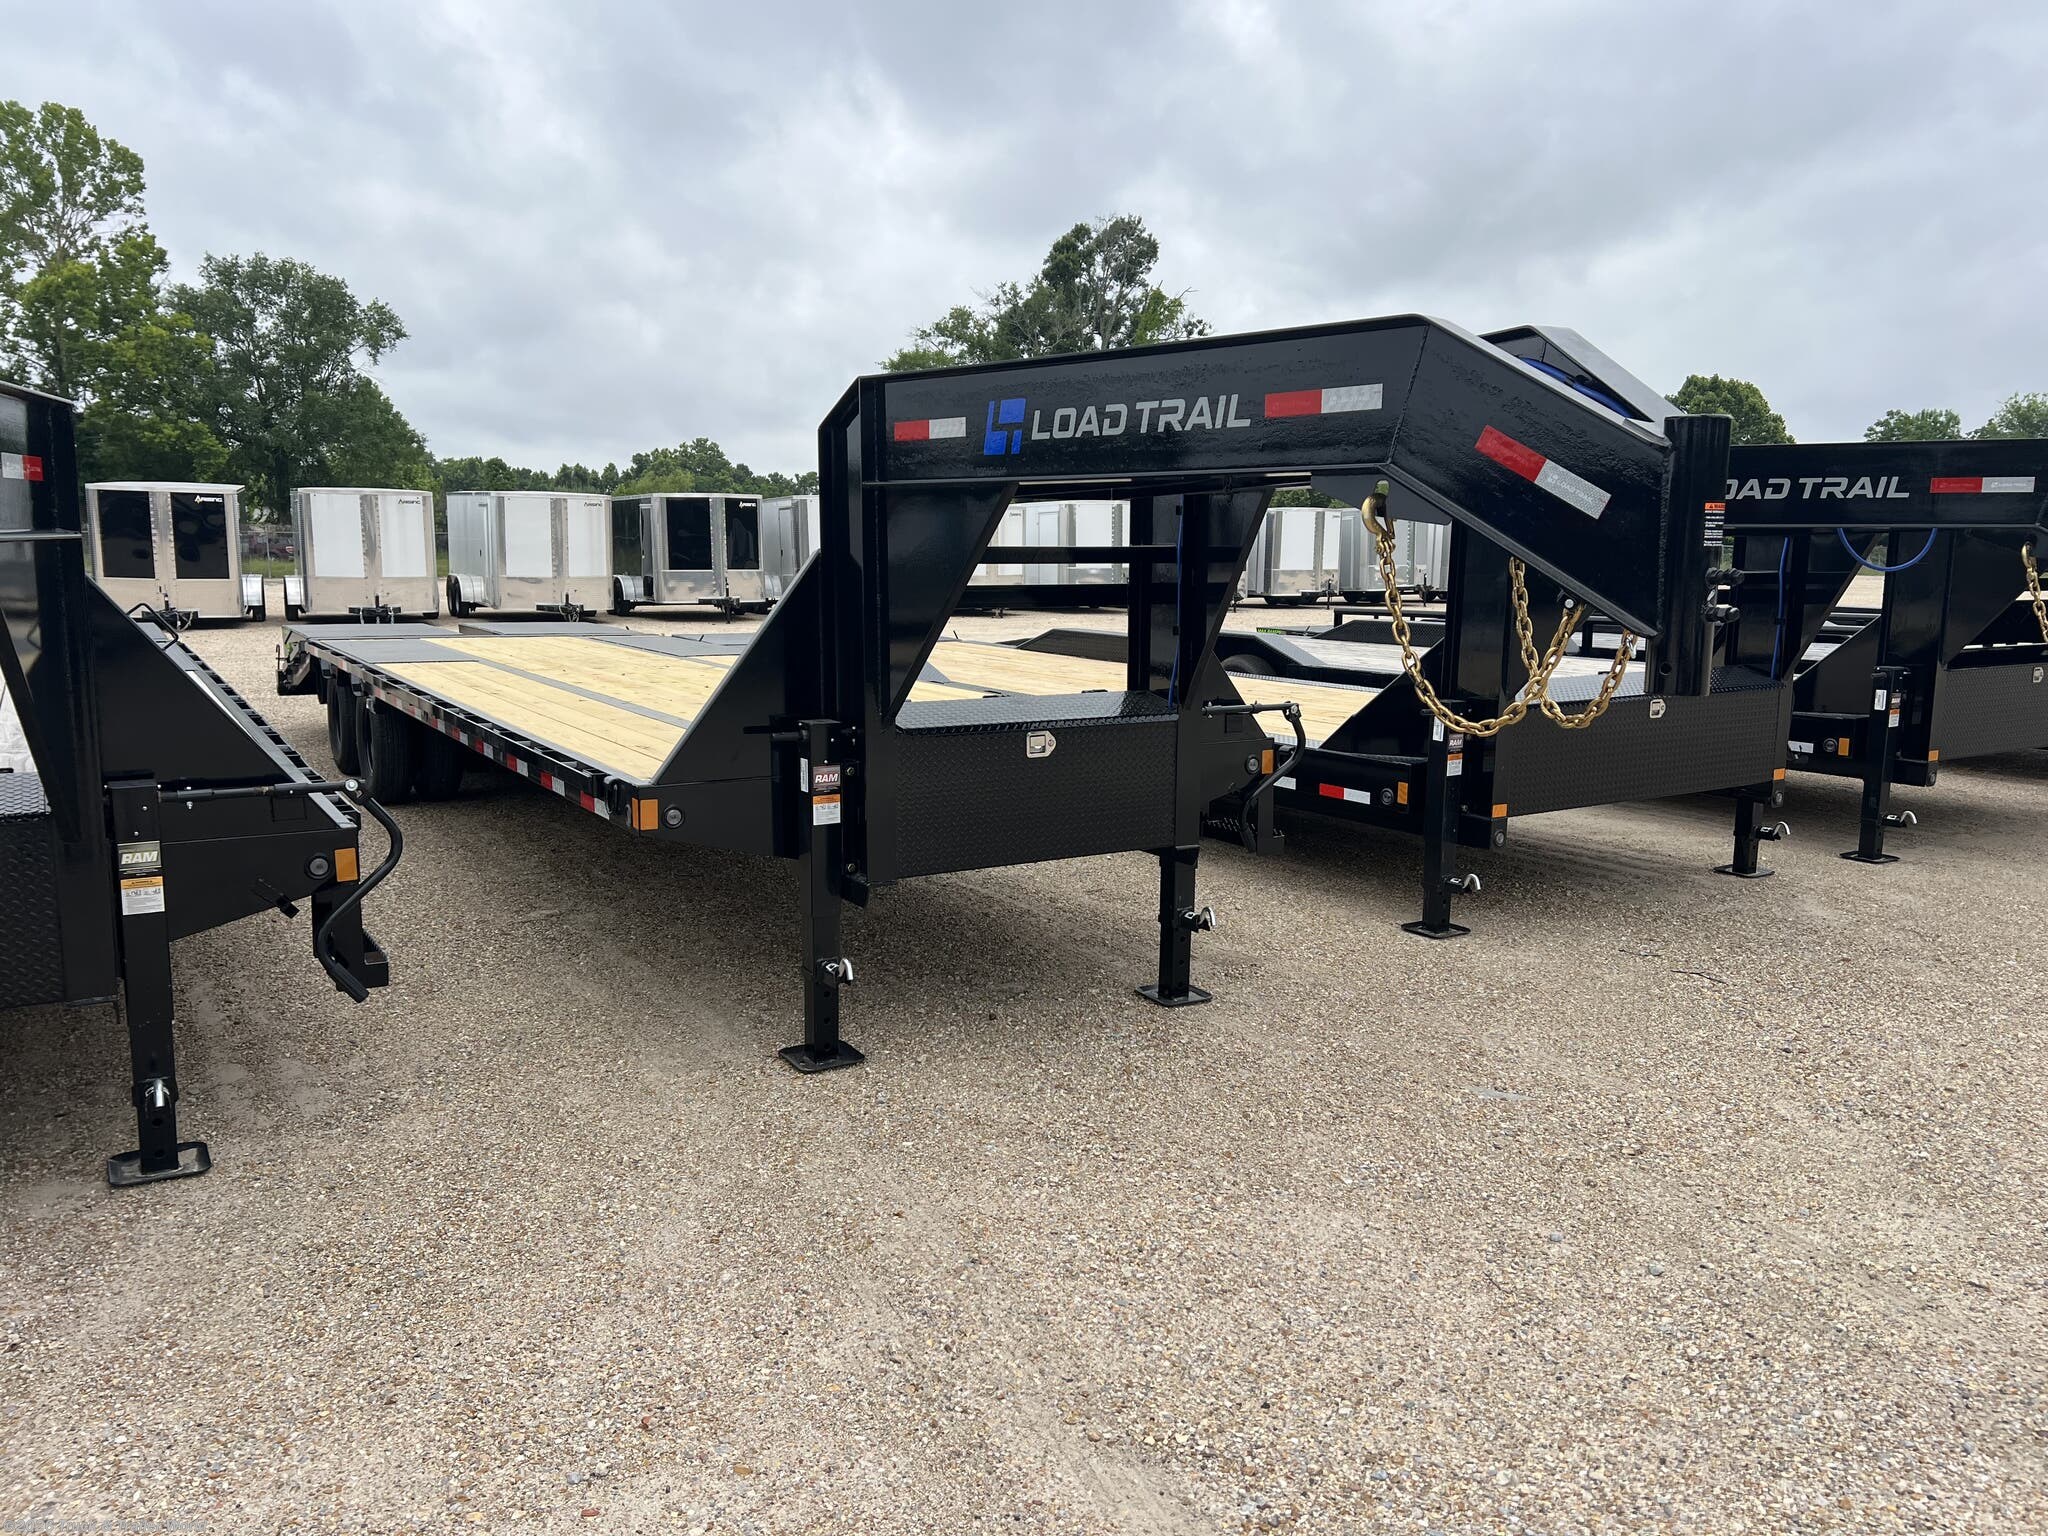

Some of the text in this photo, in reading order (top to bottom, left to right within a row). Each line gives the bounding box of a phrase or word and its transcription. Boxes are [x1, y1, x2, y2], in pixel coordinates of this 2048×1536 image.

[1031, 394, 1250, 440] LOAD TRAIL
[1725, 476, 1910, 500] OAD TRAIL
[815, 773, 838, 783] RAM
[121, 851, 158, 865] RAM
